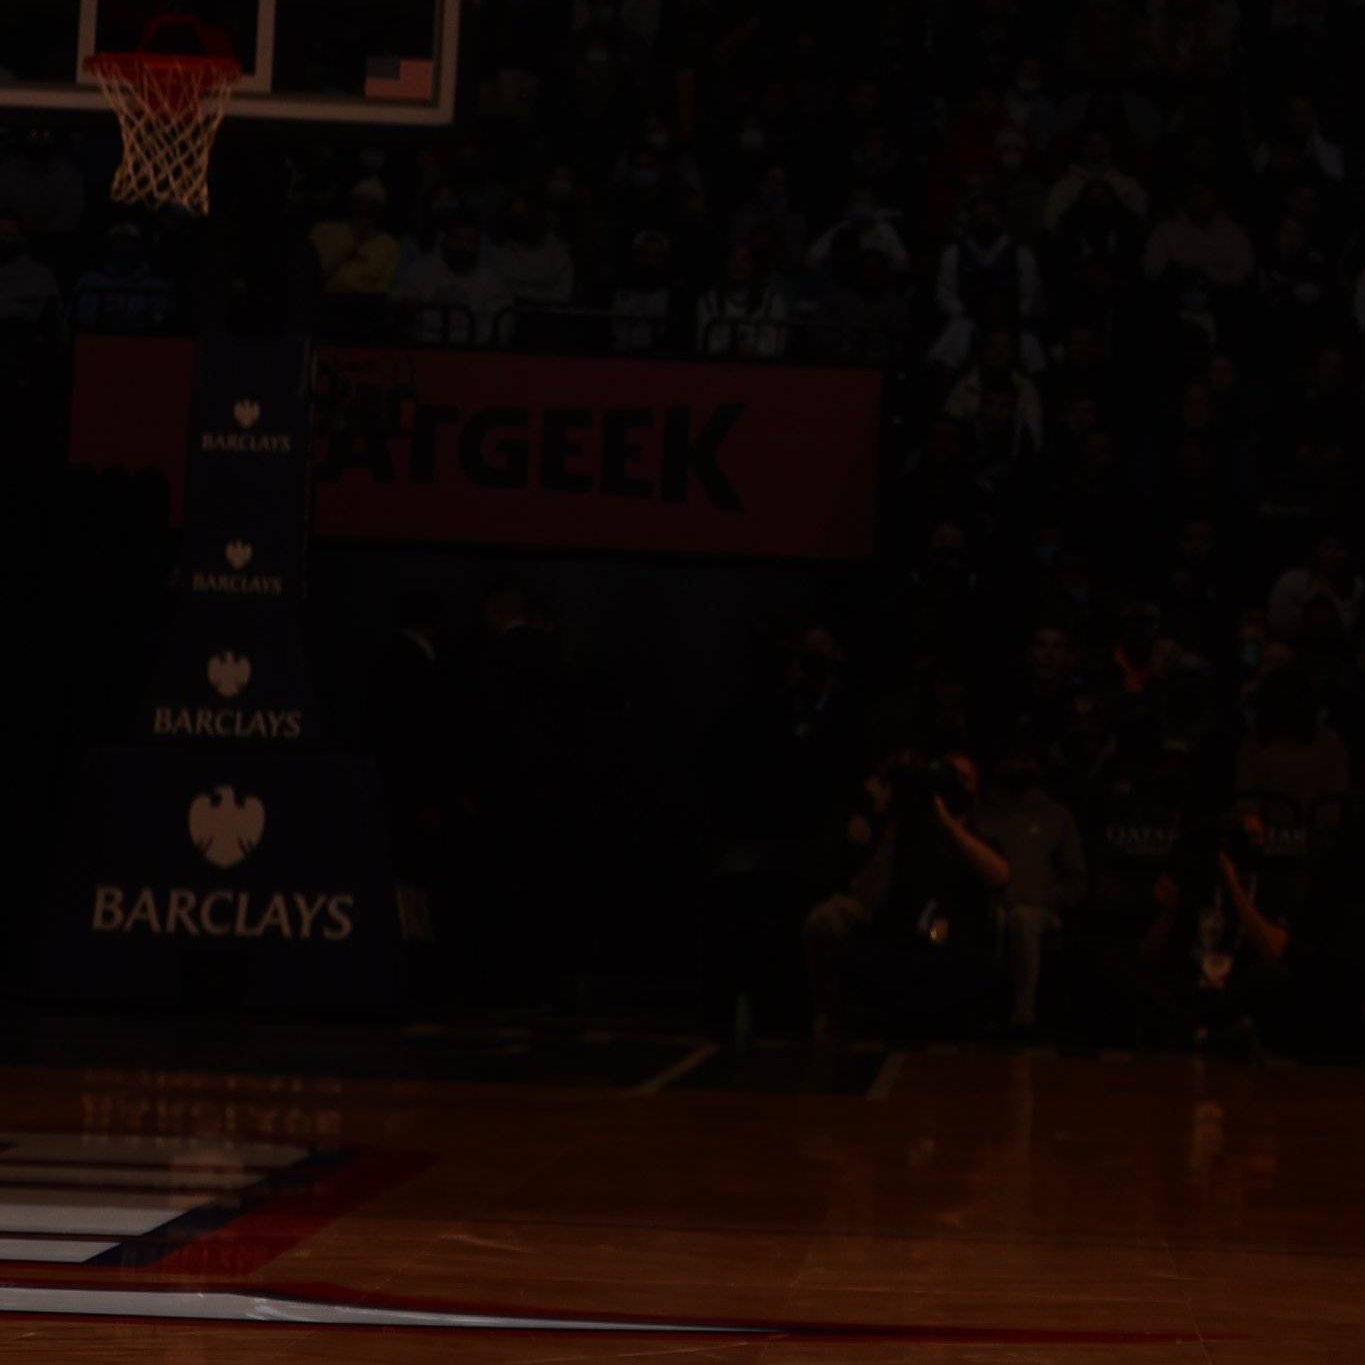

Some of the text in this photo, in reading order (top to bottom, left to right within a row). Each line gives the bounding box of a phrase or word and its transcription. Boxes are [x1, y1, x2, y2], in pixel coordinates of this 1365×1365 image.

[201, 431, 293, 456] BARCLAYS
[315, 400, 747, 515] ATGEEK
[192, 573, 284, 597] BARCLAYS
[152, 706, 304, 739] BARCLAYS
[90, 885, 356, 942] BARCLAYS
